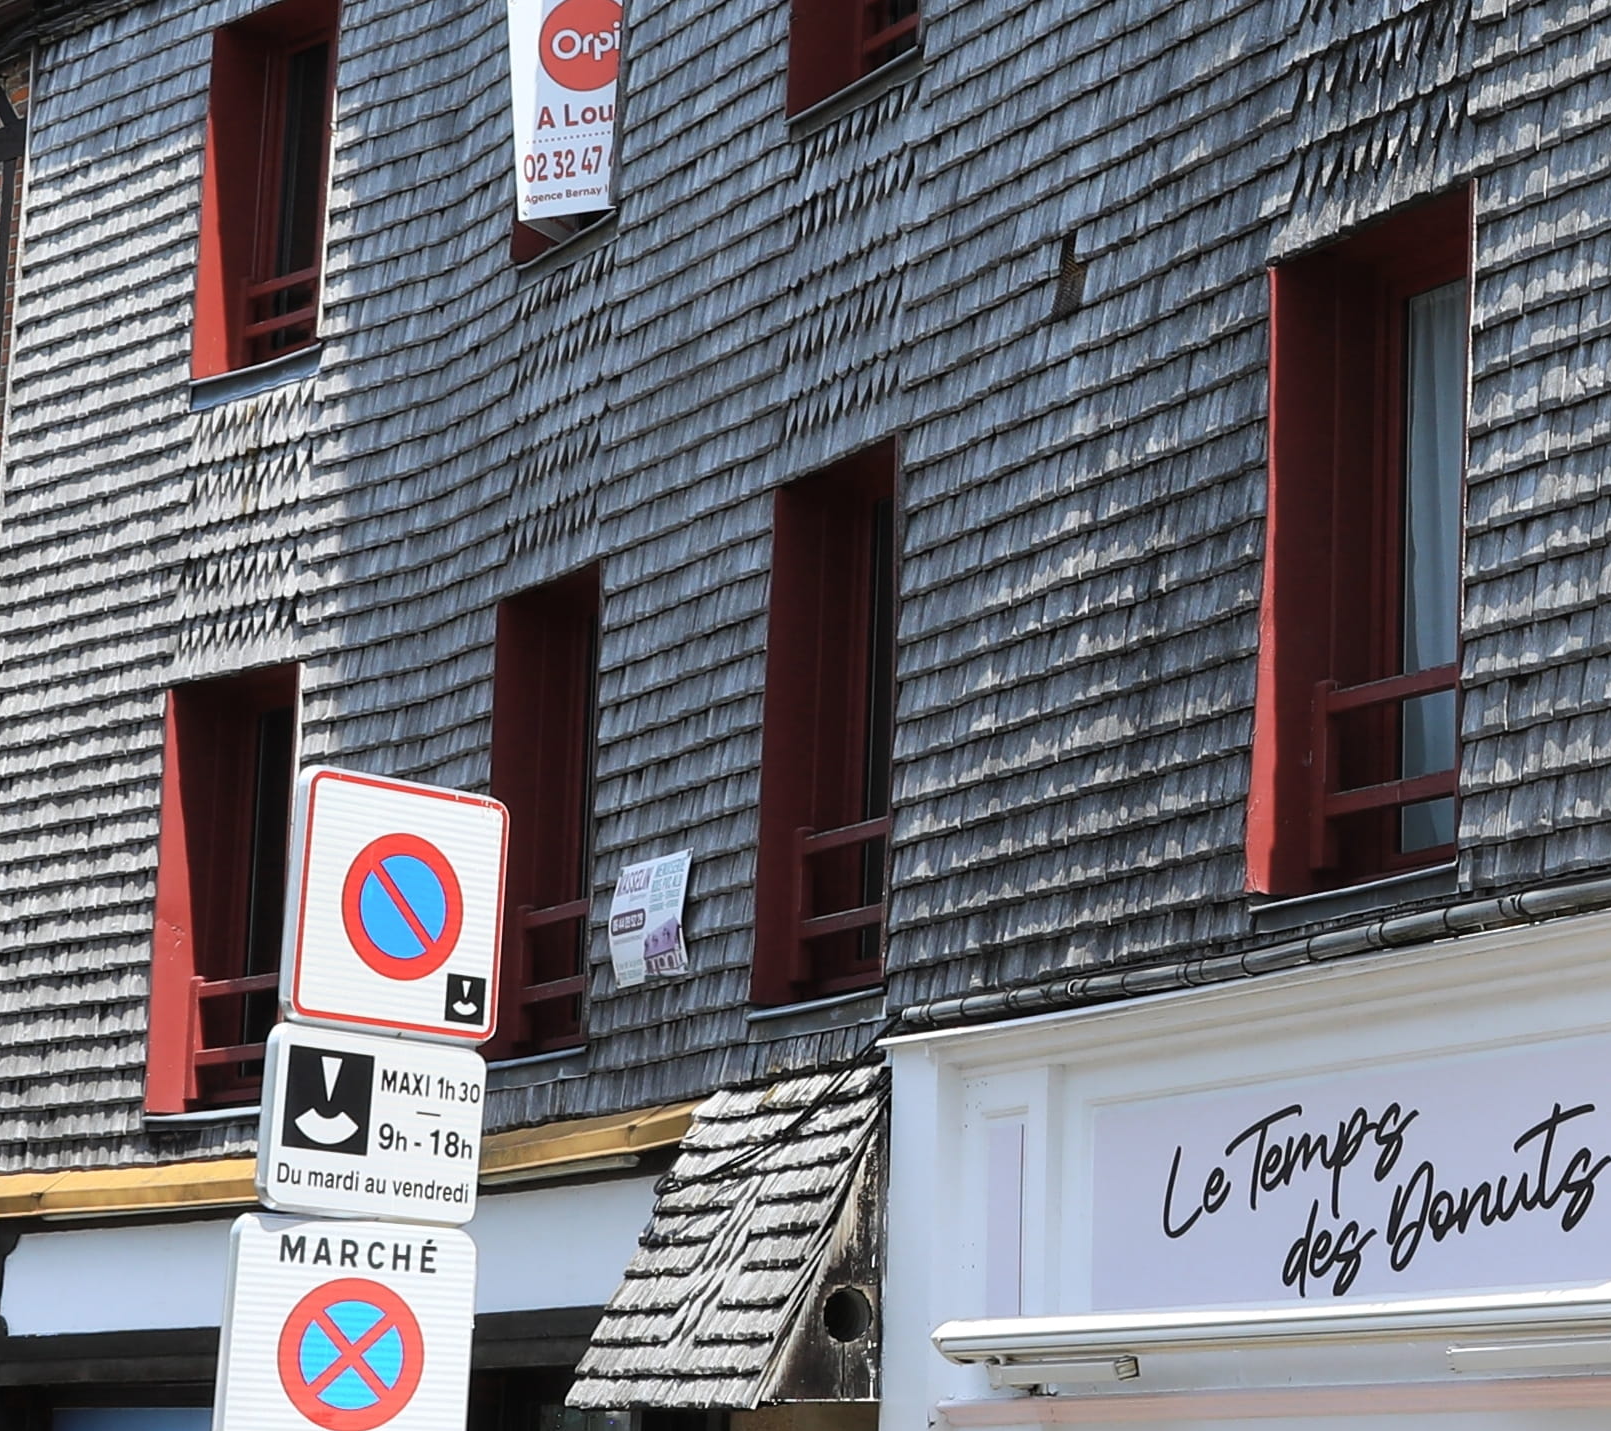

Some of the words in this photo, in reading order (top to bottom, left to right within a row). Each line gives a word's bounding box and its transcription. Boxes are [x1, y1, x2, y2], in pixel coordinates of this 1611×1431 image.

[551, 21, 621, 61] Orpi
[537, 106, 556, 130] A
[524, 152, 549, 183] 02
[553, 149, 576, 180] 32
[581, 145, 603, 175] 47
[525, 191, 563, 205] Agence
[565, 185, 602, 199] Bernay
[380, 1068, 431, 1098] MAXI
[378, 1124, 407, 1152] 9h
[429, 1127, 473, 1160] 18h
[276, 1162, 301, 1187] Du
[307, 1165, 359, 1192] mardi
[365, 1176, 388, 1195] au
[393, 1175, 470, 1205] vendredi
[1161, 1145, 1231, 1240] Le
[1225, 1101, 1420, 1220] Temps
[279, 1234, 439, 1274] MARCHÉ
[1282, 1206, 1378, 1299] des
